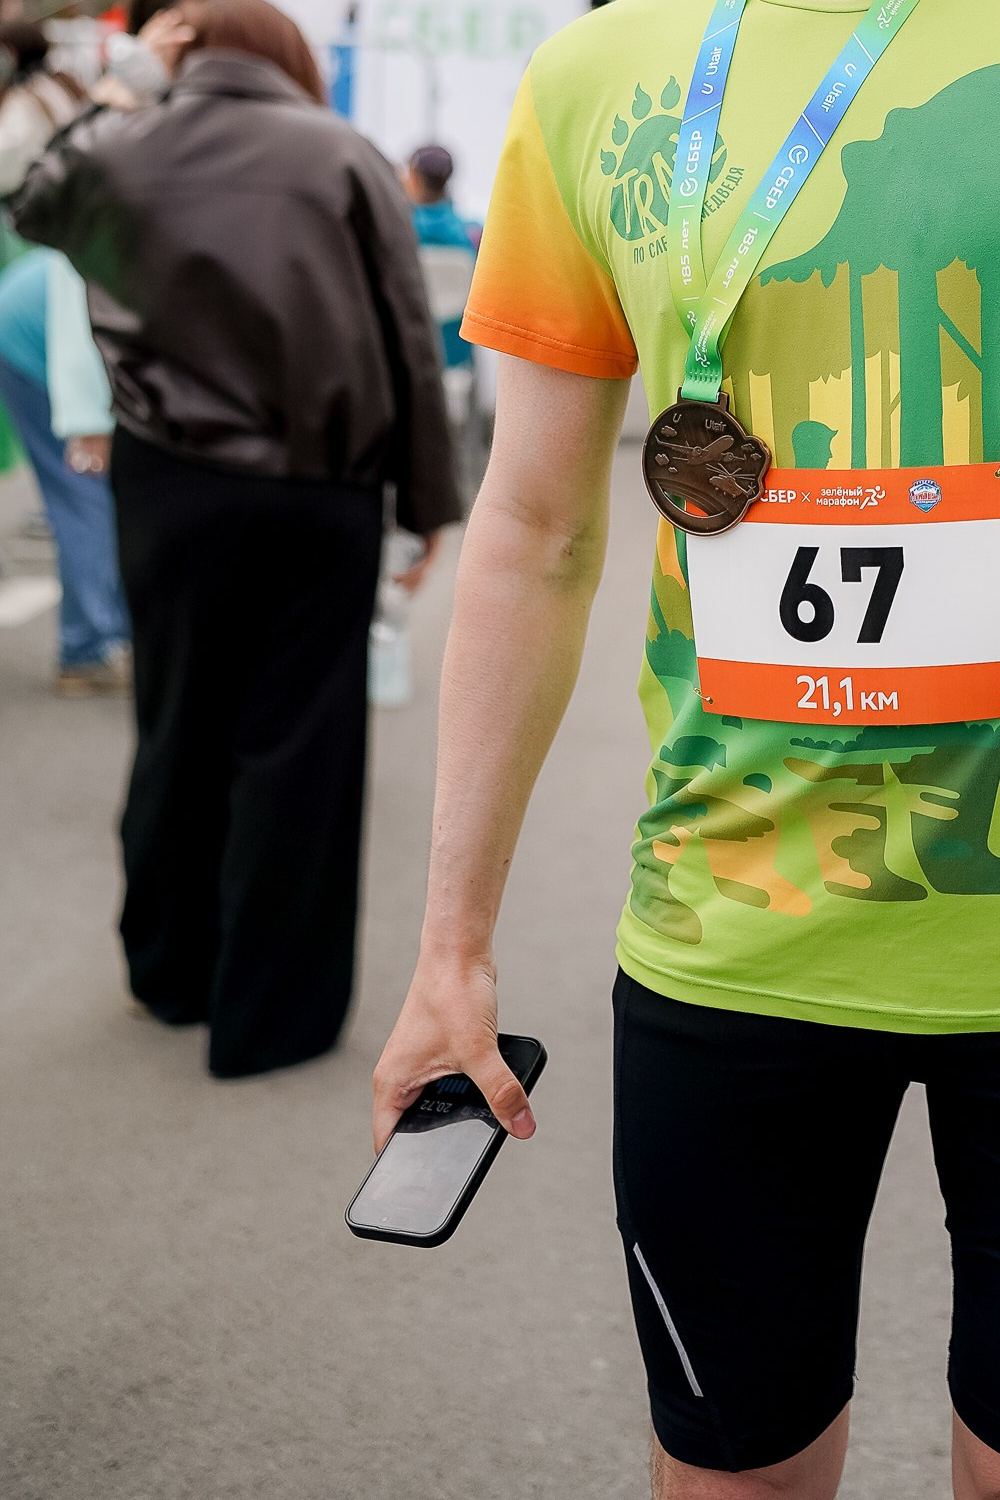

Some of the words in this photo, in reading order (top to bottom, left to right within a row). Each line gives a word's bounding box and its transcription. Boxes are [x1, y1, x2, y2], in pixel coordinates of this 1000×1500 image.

[706, 46, 723, 76] Utair
[821, 81, 847, 113] Utair
[686, 130, 703, 174] СБЕР
[765, 166, 795, 209] СБЕР
[633, 247, 645, 265] ПО
[700, 166, 745, 223] МЕДВЕДЯ
[681, 218, 690, 249] лет
[737, 227, 758, 256] 185
[680, 254, 693, 286] 185
[722, 257, 740, 289] лет
[815, 496, 860, 508] марафон
[820, 485, 863, 497] зелёный
[779, 546, 905, 643] 67
[796, 675, 854, 717] 21,1
